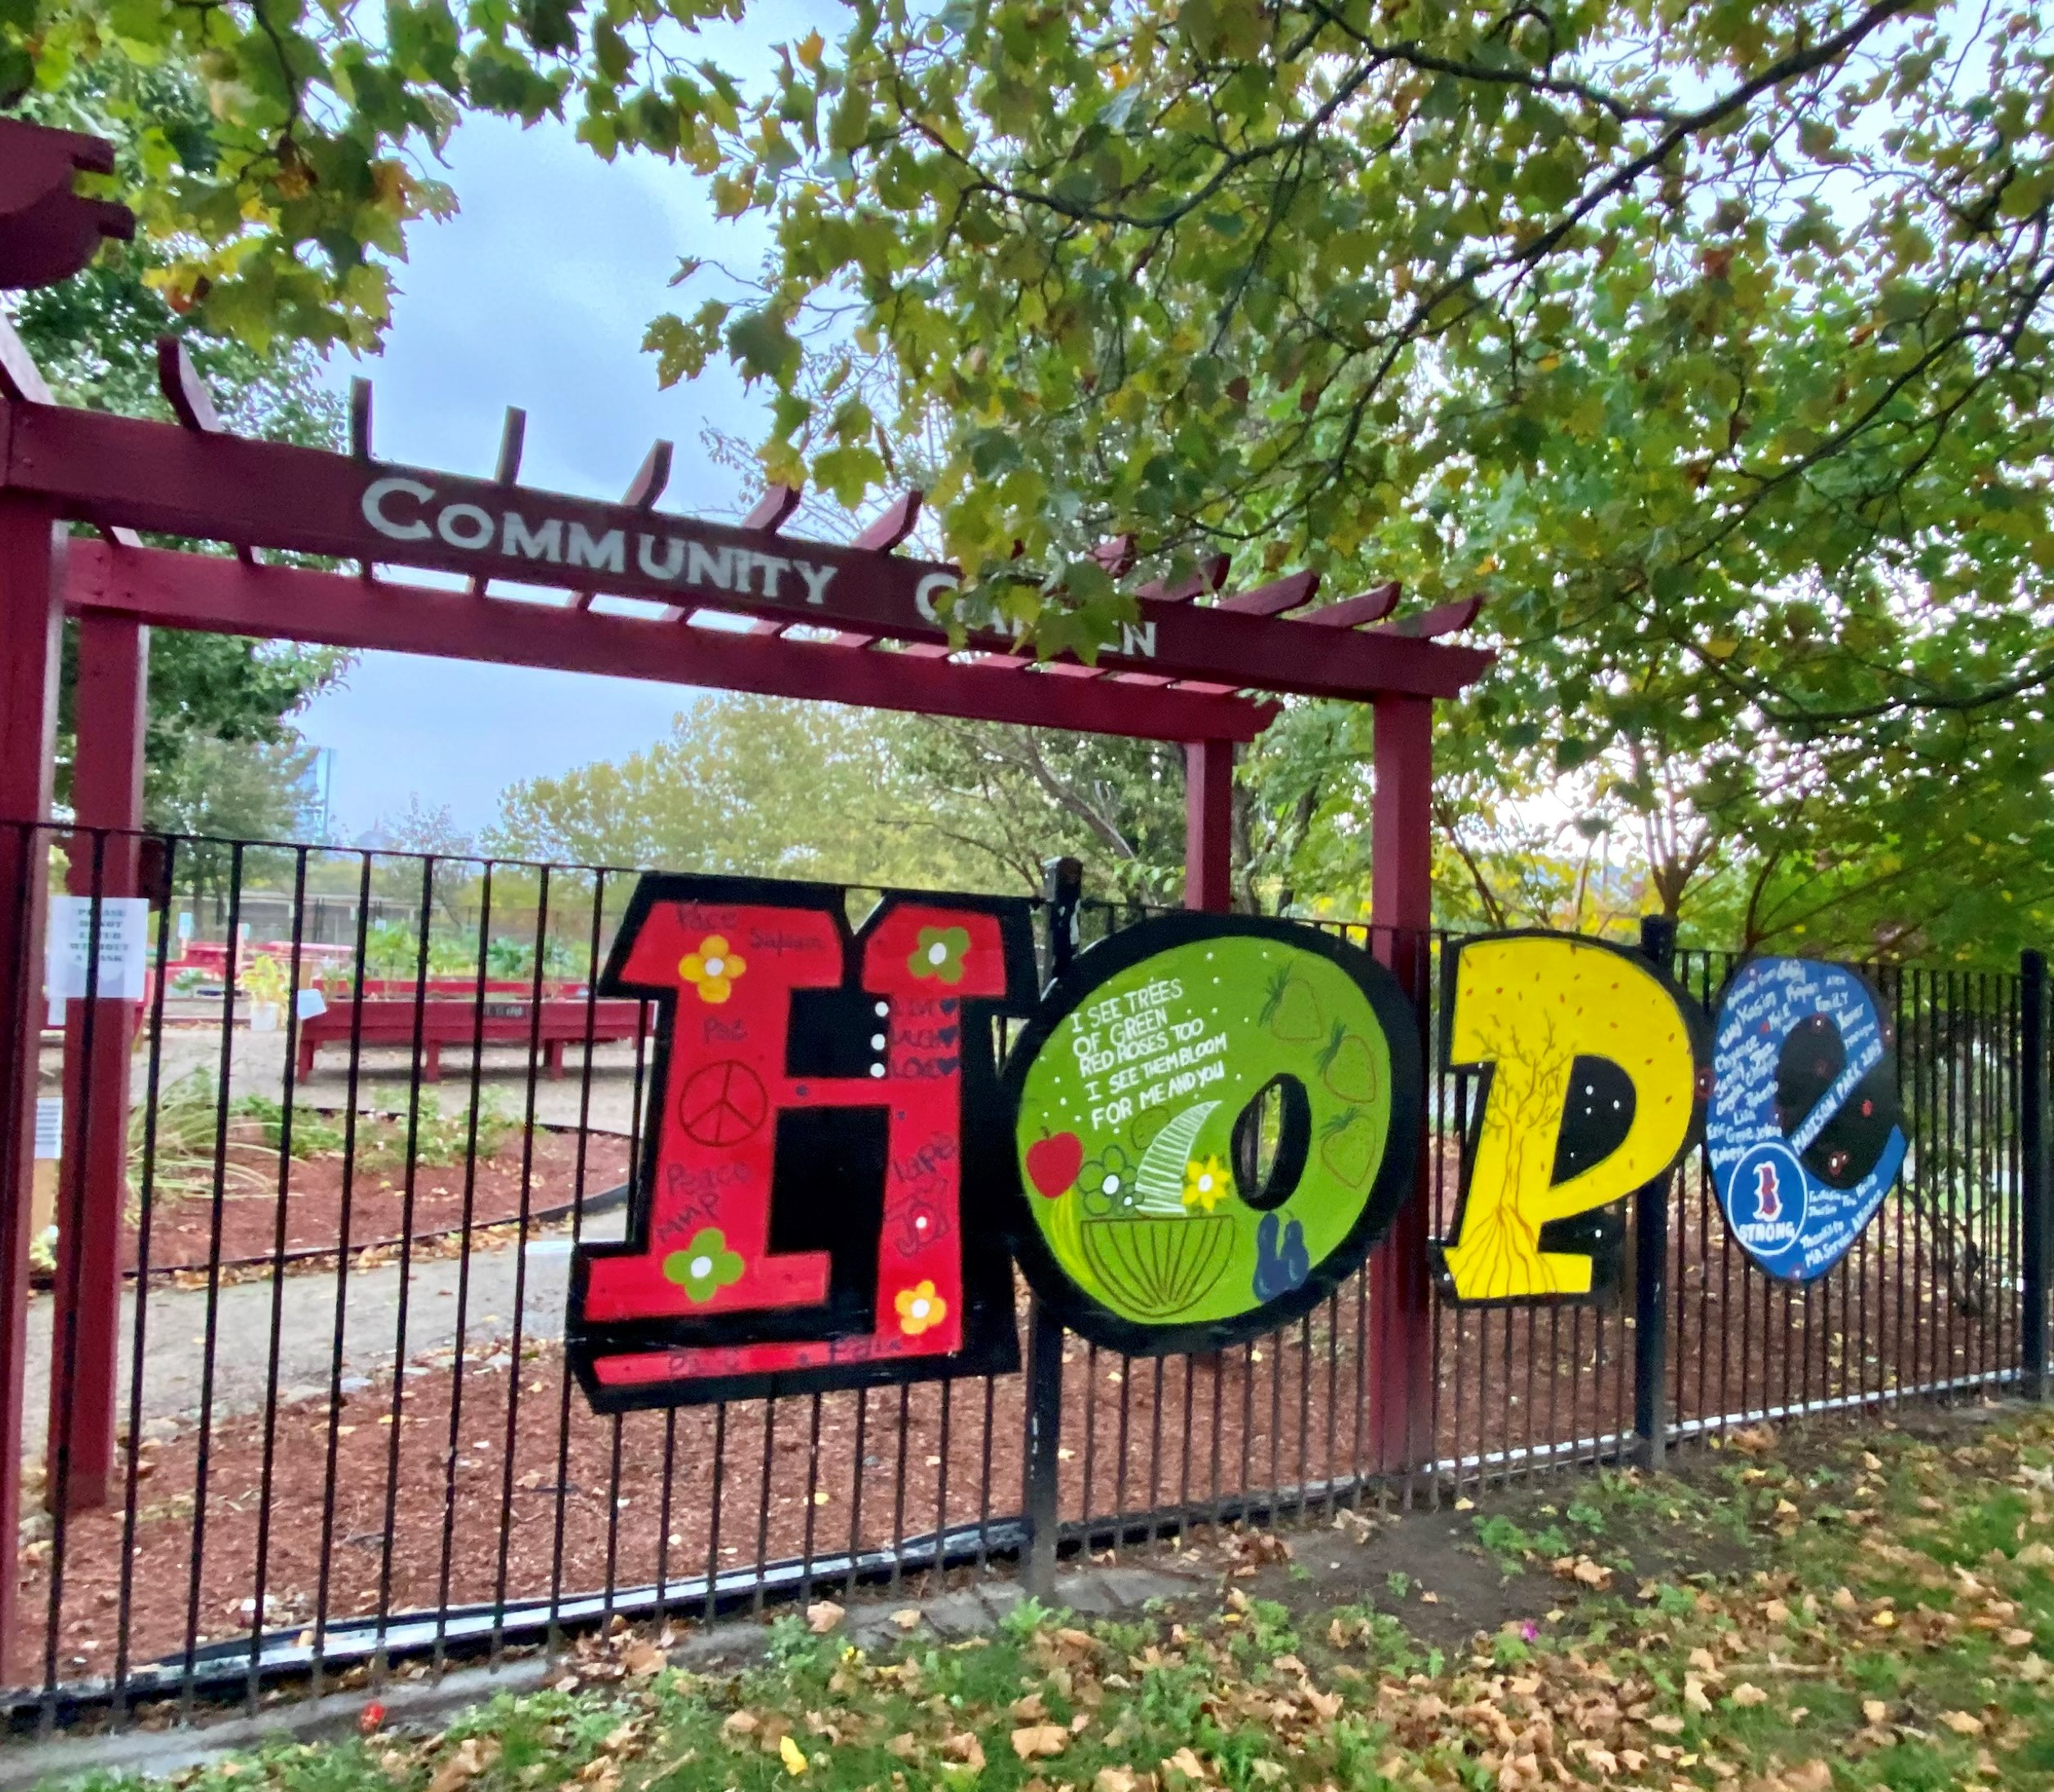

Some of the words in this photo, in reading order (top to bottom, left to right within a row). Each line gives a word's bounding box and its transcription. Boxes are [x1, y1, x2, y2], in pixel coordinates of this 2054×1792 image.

[362, 477, 838, 605] COMMUNITY
[1070, 1012, 1083, 1033] I
[1088, 997, 1123, 1028] SEE
[1123, 979, 1183, 1013] TREES
[1073, 1032, 1101, 1058] OF
[1110, 1006, 1168, 1046] GREEN
[1079, 1050, 1114, 1078] RED
[1117, 1031, 1169, 1063] ROSES
[1169, 1018, 1204, 1042] TOO
[1084, 1081, 1101, 1101] I
[1109, 1067, 1140, 1095] SEE
[1092, 1096, 1132, 1131] FOR
[1139, 1083, 1167, 1110] ME
[1168, 1072, 1196, 1099] AND
[1196, 1060, 1225, 1088] YOU
[1737, 1221, 1796, 1243] STRONG
